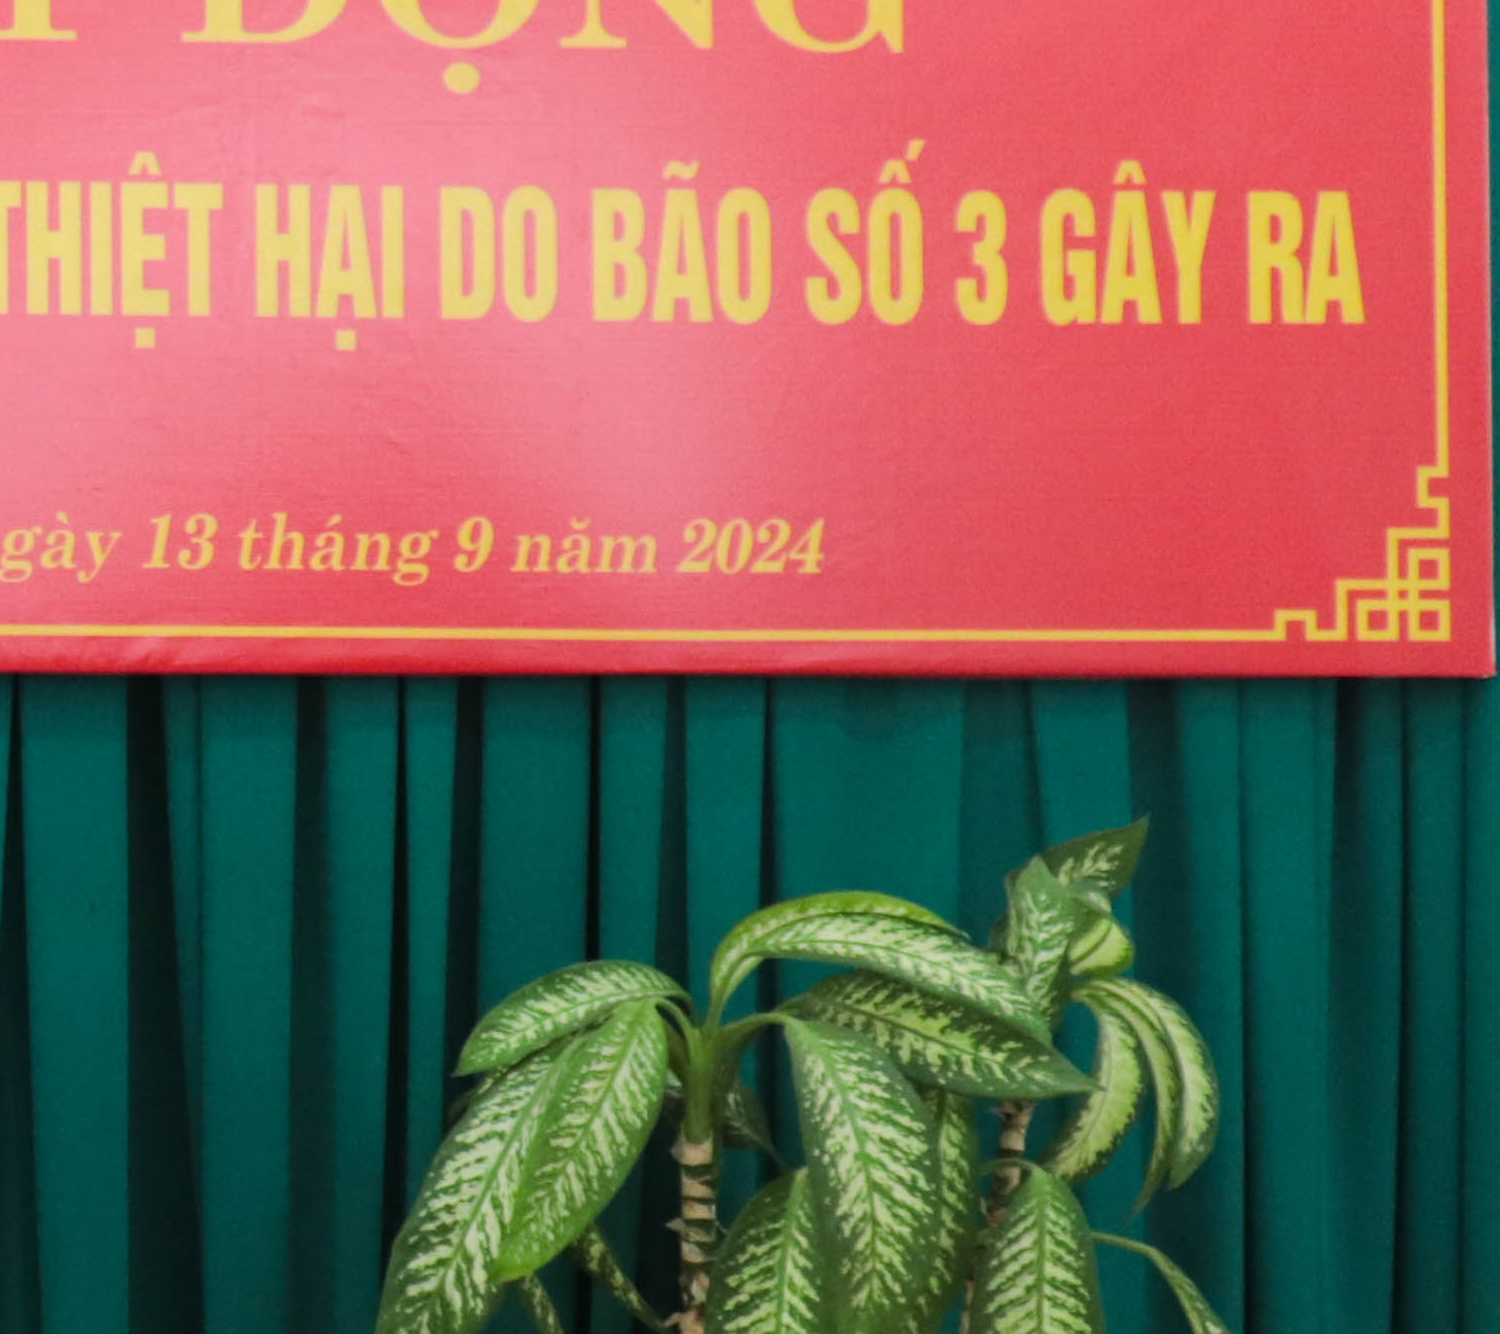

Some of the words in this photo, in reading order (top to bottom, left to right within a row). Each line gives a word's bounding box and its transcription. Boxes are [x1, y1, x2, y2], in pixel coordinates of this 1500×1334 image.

[255, 182, 404, 350] HẠI
[437, 183, 557, 321] DO
[590, 163, 772, 323] BÃO
[806, 140, 926, 324] SỐ
[956, 190, 1007, 324] 3
[1040, 160, 1216, 324] GÂY
[1246, 190, 1365, 324] RA
[142, 515, 216, 570] 13
[237, 515, 438, 585] tháng
[452, 515, 494, 573] 9
[510, 520, 658, 574] năm
[679, 518, 827, 576] 2024
